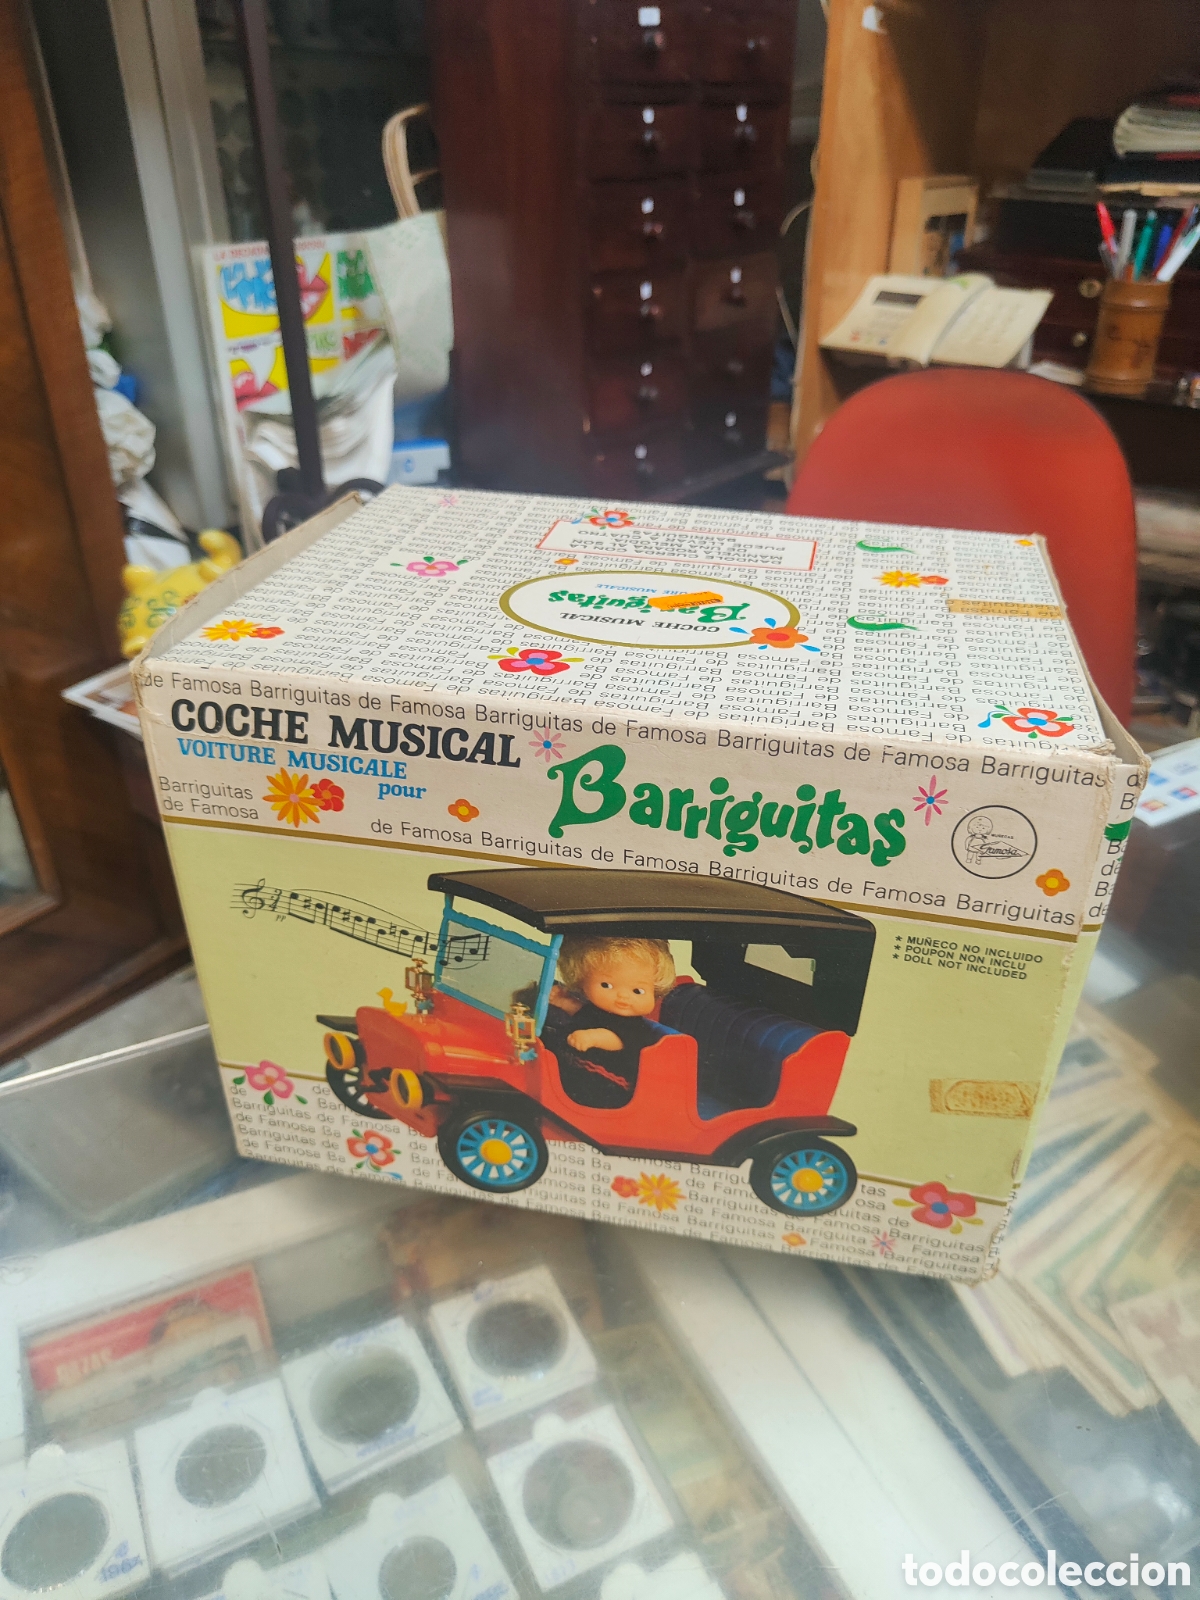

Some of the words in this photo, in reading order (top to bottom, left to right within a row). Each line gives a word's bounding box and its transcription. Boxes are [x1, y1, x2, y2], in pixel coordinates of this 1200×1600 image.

[556, 612, 645, 626] MUSICAL
[651, 621, 720, 632] COCHE
[279, 640, 353, 653] Famosa
[291, 634, 392, 649] Barriguitas
[270, 649, 373, 665] Barriguitas
[357, 648, 383, 656] de
[395, 644, 470, 658] Famosa
[259, 654, 335, 668] Famosa
[338, 662, 365, 671] de
[378, 659, 455, 673] Famosa
[385, 653, 489, 668] Barriguitas
[367, 667, 475, 683] Barriguitas
[460, 668, 486, 677] de
[491, 672, 597, 688] Barriguitas
[357, 674, 439, 691] Famosa
[443, 683, 471, 694] de
[480, 679, 560, 693] Famosa
[603, 683, 682, 697] Famosa
[609, 675, 715, 691] Barriguitas
[566, 688, 592, 696] de
[690, 692, 716, 701] de
[725, 685, 803, 698] Famosa
[813, 692, 838, 701] de
[592, 700, 673, 715] Famosa
[597, 692, 708, 709] Barriguitas
[724, 694, 836, 711] Barriguitas
[848, 695, 962, 712] Barriguitas
[682, 709, 709, 719] de
[719, 703, 799, 717] Famosa
[810, 710, 836, 720] de
[848, 704, 931, 719] Famosa
[943, 712, 969, 722] de
[717, 712, 834, 731] Barriguitas
[846, 714, 965, 732] Barriguitas
[167, 697, 312, 745] COCHE
[328, 714, 521, 769] MUSICAL
[170, 672, 242, 696] Famosa
[249, 679, 351, 706] Barriguitas
[357, 691, 381, 711] de
[389, 695, 465, 720] Famosa
[475, 703, 582, 732] Barriguitas
[592, 716, 616, 736] de
[626, 719, 706, 746] Famosa
[717, 728, 835, 757] Barriguitas
[844, 742, 870, 762] de
[881, 744, 970, 773] Famosa
[981, 755, 1108, 787] Barriguitas
[846, 723, 933, 741] Famosa
[944, 732, 971, 744] de
[177, 737, 276, 765] VOITURE
[285, 749, 408, 780] MUSICALE
[160, 776, 253, 801] Barriguitas
[376, 780, 427, 805] pour
[165, 795, 184, 811] de
[190, 799, 259, 820] Famosa
[549, 745, 906, 865] Barriguitas
[370, 818, 393, 834] de
[400, 821, 472, 845] Famosa
[481, 831, 582, 858] Barriguitas
[591, 845, 614, 863] de
[623, 849, 699, 874] Famosa
[709, 860, 819, 887] Barriguitas
[827, 877, 853, 894] de
[862, 880, 946, 907] Famosa
[956, 894, 1077, 923] Barriguitas
[906, 934, 958, 950] MUÑECO
[962, 944, 980, 953] NO
[984, 947, 1043, 963] INCLUIDO
[905, 945, 954, 959] POUPON
[959, 953, 985, 964] NON
[989, 958, 1026, 970] INCLU
[903, 954, 933, 965] DOLL
[937, 959, 962, 969] NOT
[966, 963, 1027, 980] INCLUDED
[229, 1084, 247, 1096] de
[232, 1097, 311, 1119] Barriguitas
[316, 1111, 335, 1123] de
[340, 1115, 400, 1134] Famosa
[235, 1111, 252, 1122] de
[259, 1115, 315, 1133] Famosa
[322, 1125, 341, 1137] Ba
[238, 1123, 316, 1144] Barriguitas
[320, 1137, 339, 1149] de
[264, 1140, 320, 1159] Famosa
[327, 1151, 345, 1163] Ba
[409, 1139, 427, 1151] de
[685, 1177, 704, 1189] de
[688, 1190, 778, 1214] Barriguitas
[813, 1215, 880, 1235] Famosa
[888, 1227, 985, 1252] Barriguitas
[887, 1215, 909, 1228] de
[711, 1208, 775, 1227] Famosa
[911, 1244, 980, 1263] Famosa
[687, 1215, 775, 1238] Barriguitas
[883, 1250, 977, 1272] Barriguitas
